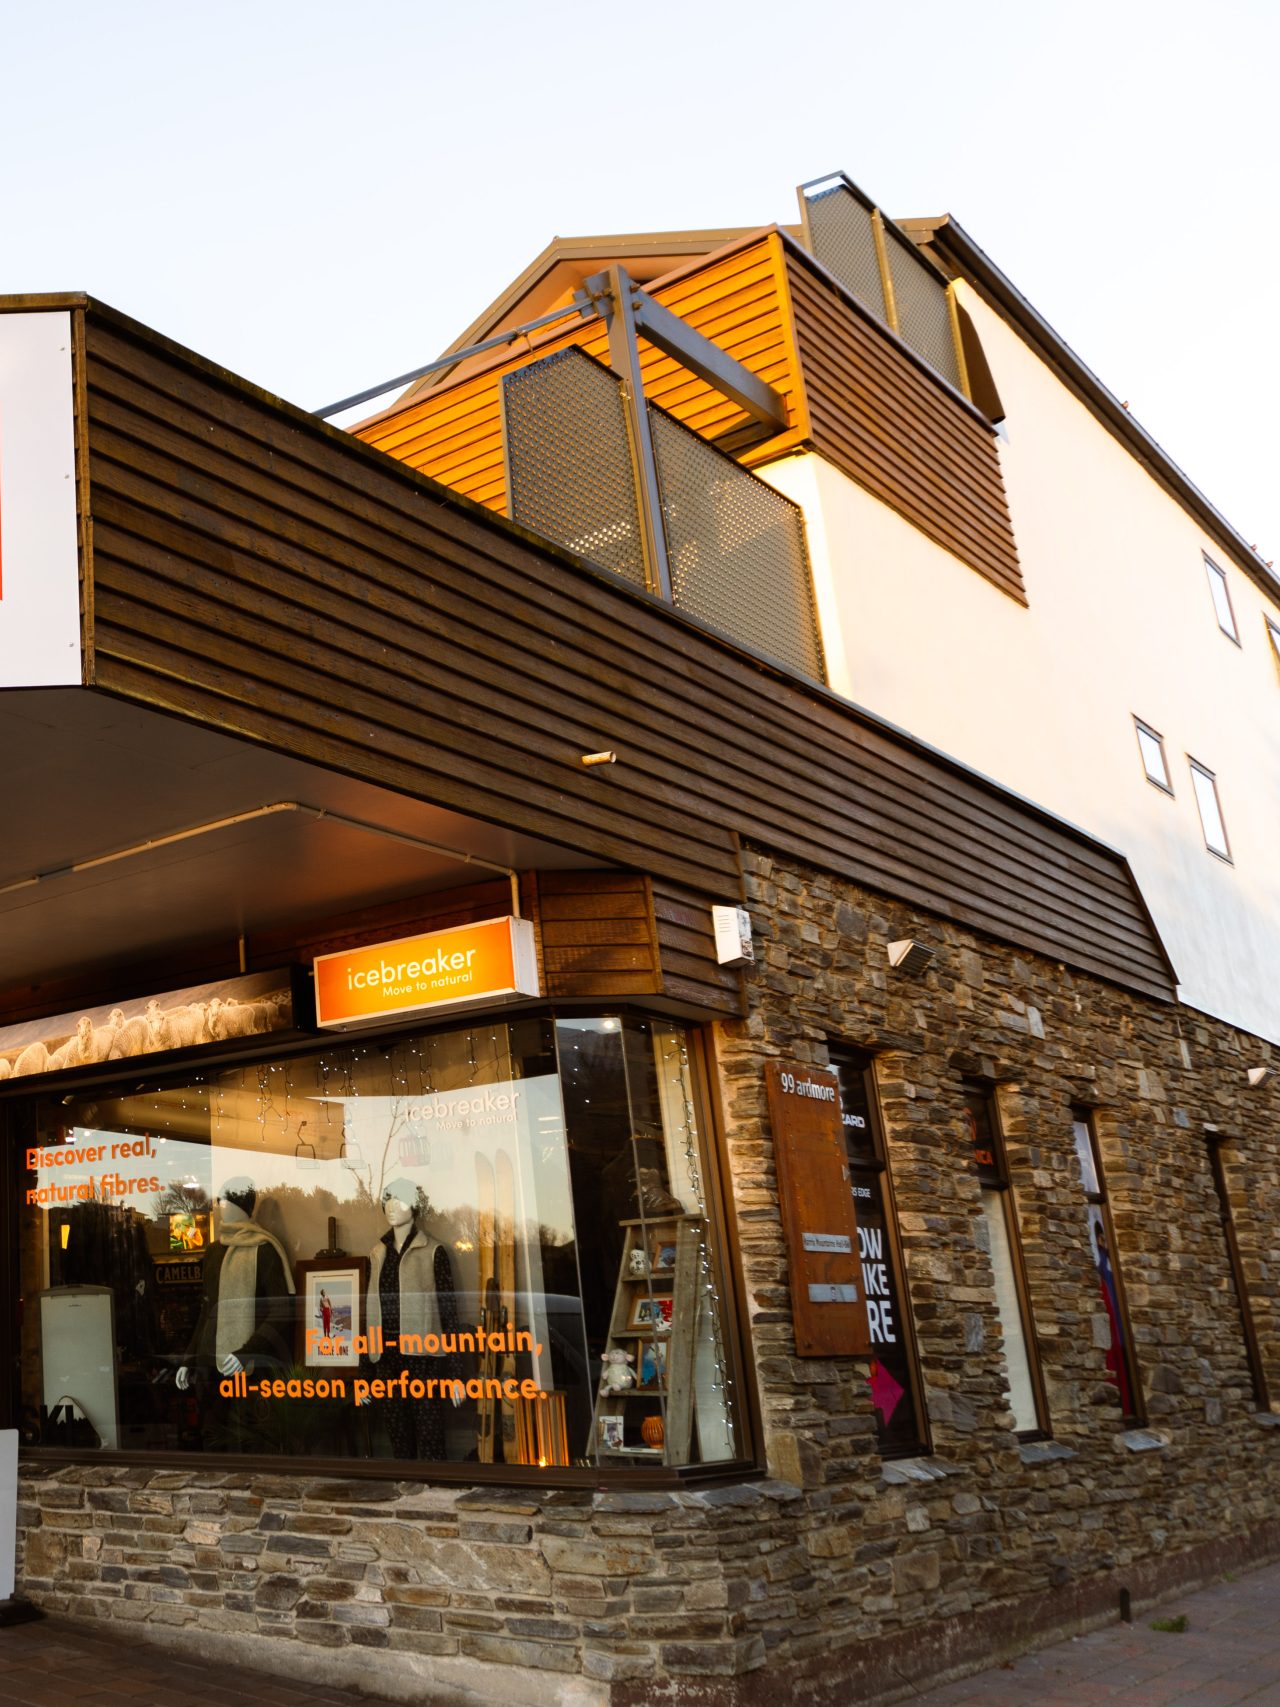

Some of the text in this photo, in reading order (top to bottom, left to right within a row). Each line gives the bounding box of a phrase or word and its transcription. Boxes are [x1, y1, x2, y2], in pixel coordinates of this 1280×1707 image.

[347, 948, 476, 991] icebreaker
[382, 972, 473, 998] Move to natural
[781, 1072, 835, 1103] 99 ardmore
[404, 1089, 520, 1122] icebreaker
[436, 1112, 518, 1131] Move to natural
[26, 1132, 157, 1170] Discover real,
[26, 1172, 166, 1205] natural fibres.
[305, 1322, 543, 1358] For all-mountain,
[219, 1369, 547, 1407] all-season performance.
